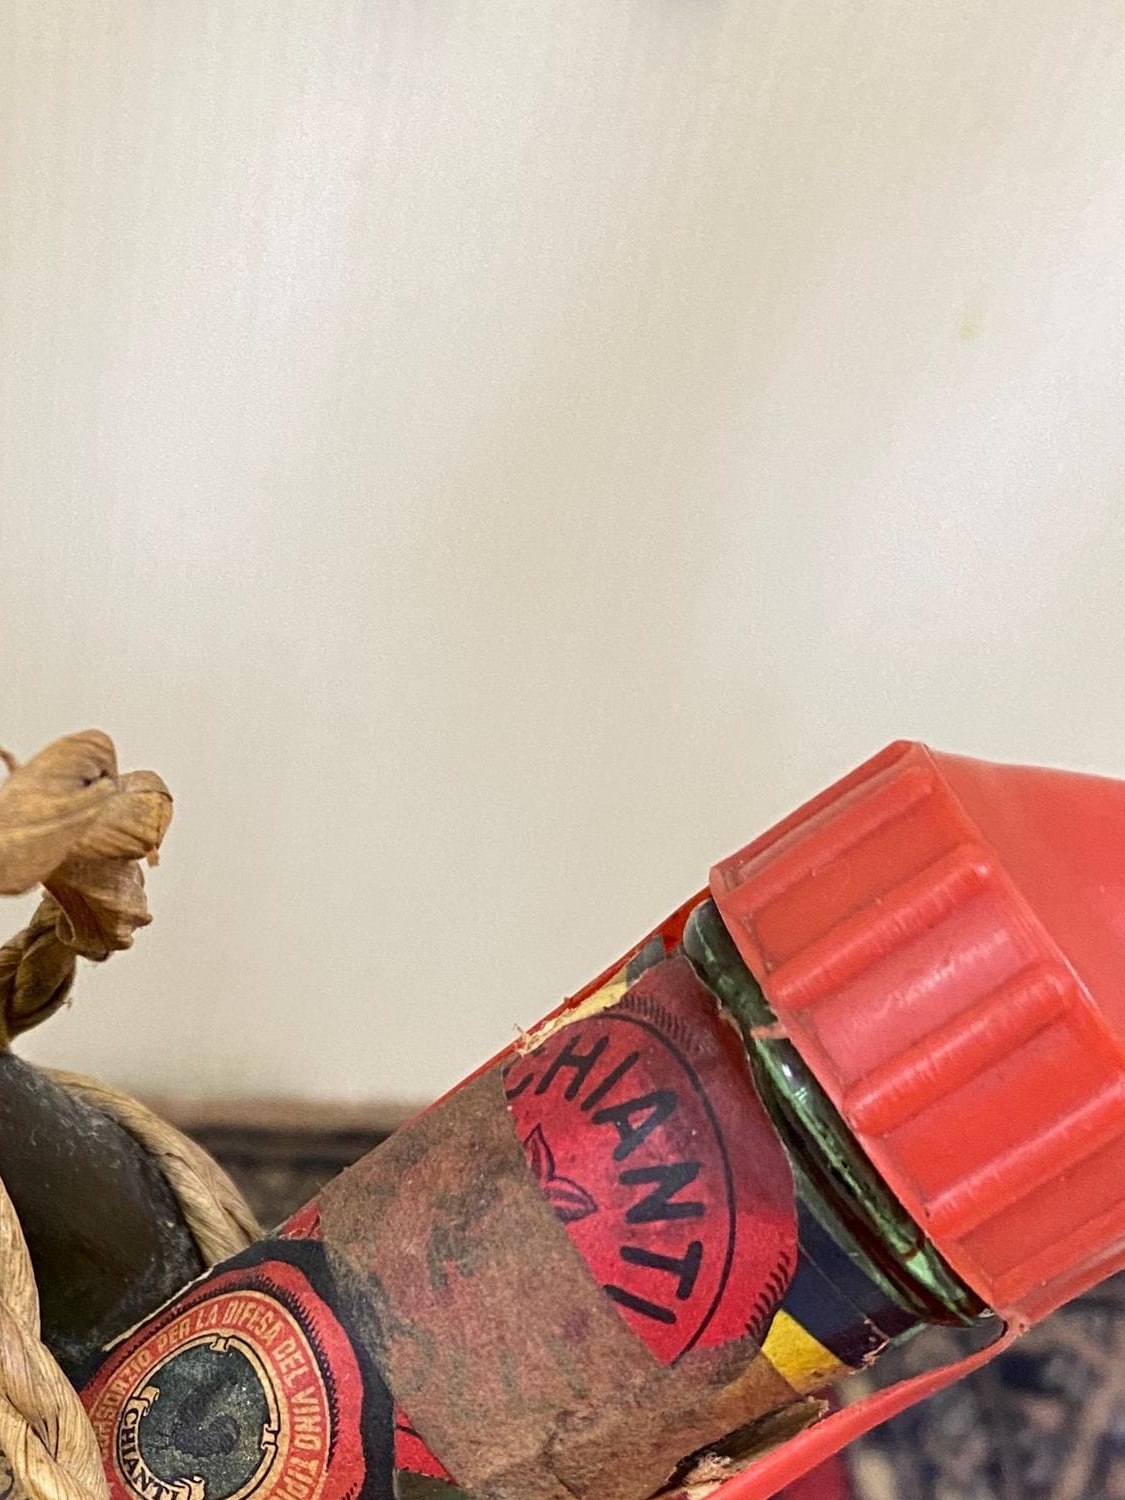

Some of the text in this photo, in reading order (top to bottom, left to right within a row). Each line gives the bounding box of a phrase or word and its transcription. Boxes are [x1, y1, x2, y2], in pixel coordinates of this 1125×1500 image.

[195, 1303, 220, 1330] LA
[220, 1299, 285, 1344] DIFESA
[272, 1337, 309, 1389] DEL
[290, 1386, 323, 1450] VINO
